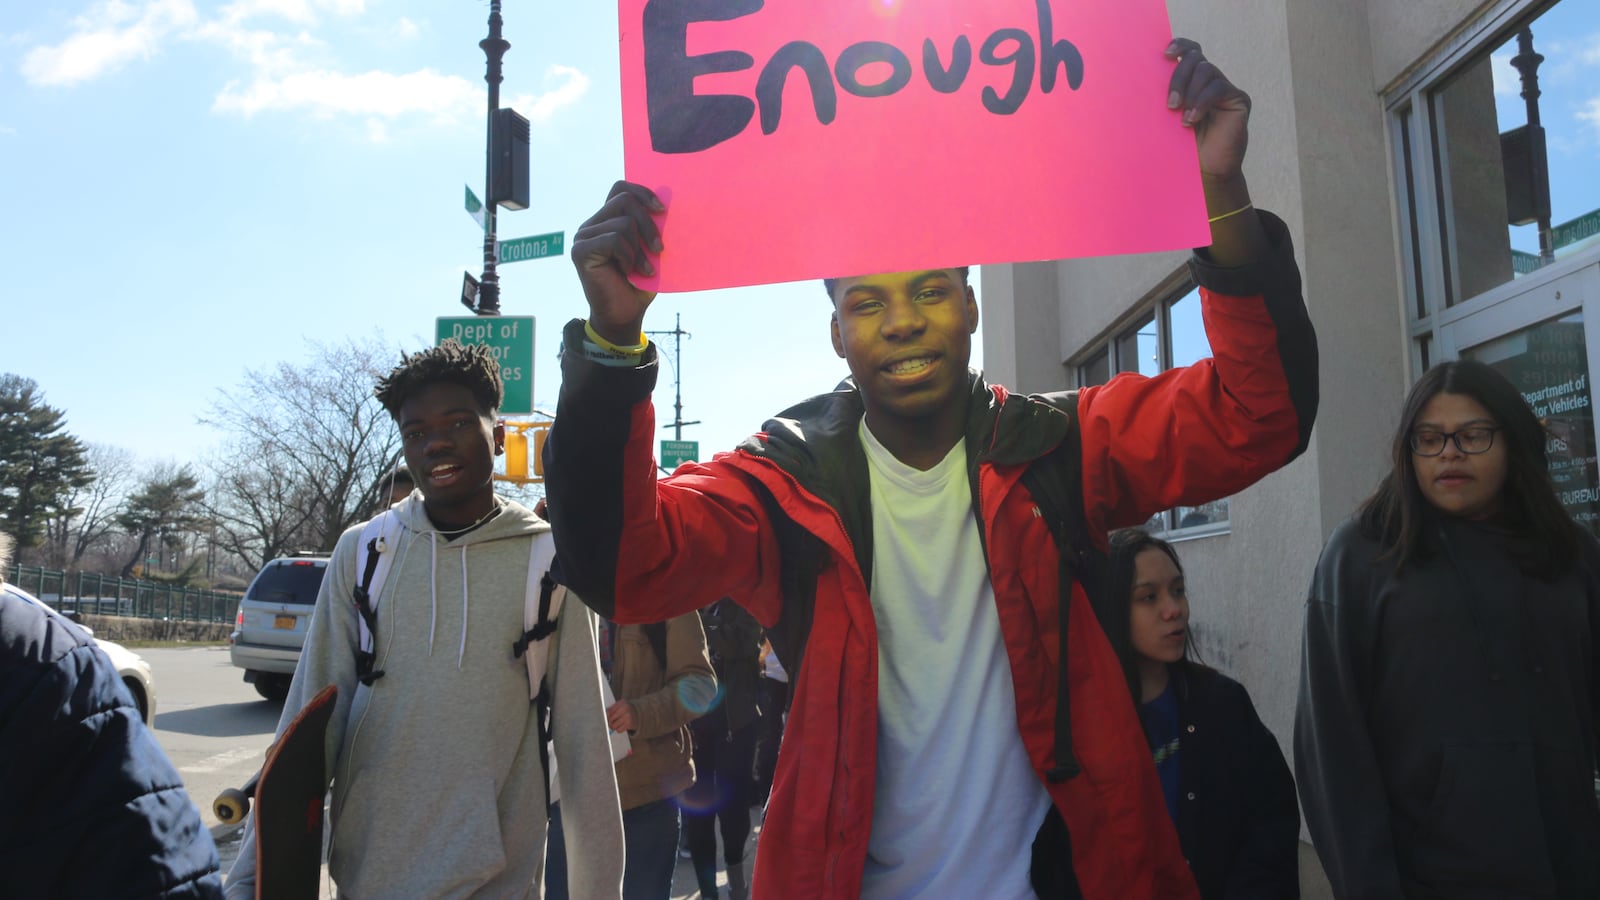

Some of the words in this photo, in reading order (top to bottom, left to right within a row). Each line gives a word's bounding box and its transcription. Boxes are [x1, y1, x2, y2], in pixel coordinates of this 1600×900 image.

[642, 0, 1084, 154] Enough
[501, 240, 548, 261] Crotona
[452, 322, 493, 342] Dept
[500, 321, 519, 339] of
[1575, 374, 1586, 390] of
[1534, 406, 1548, 418] tor
[1549, 395, 1589, 414] Vehicles
